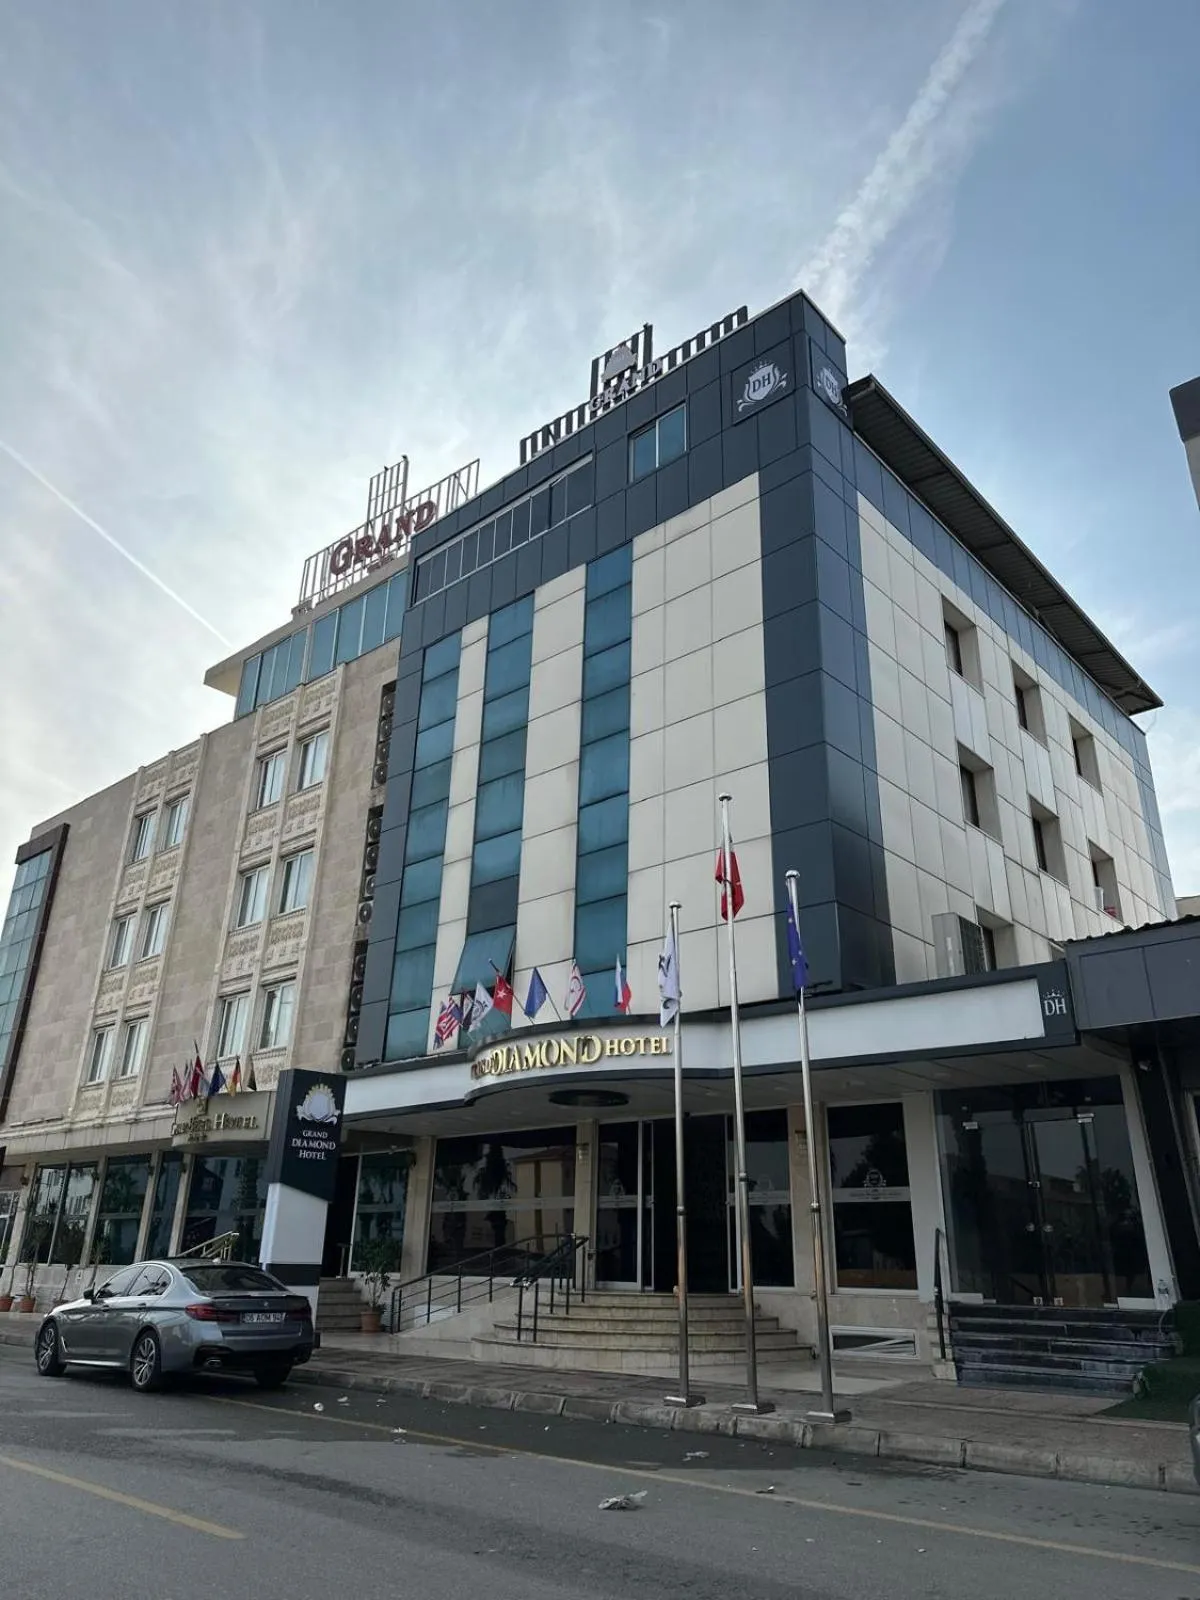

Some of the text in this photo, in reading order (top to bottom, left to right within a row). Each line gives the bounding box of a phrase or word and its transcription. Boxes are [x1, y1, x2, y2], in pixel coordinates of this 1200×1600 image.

[589, 358, 663, 412] GRAND
[752, 372, 771, 393] DH
[330, 500, 437, 576] GRAND
[1044, 998, 1067, 1016] DH
[491, 1035, 602, 1075] DIAMOND
[605, 1037, 673, 1056] HOTEL
[291, 1138, 336, 1150] DIAMOND
[302, 1130, 328, 1139] GRAND
[299, 1150, 326, 1160] HOTEL
